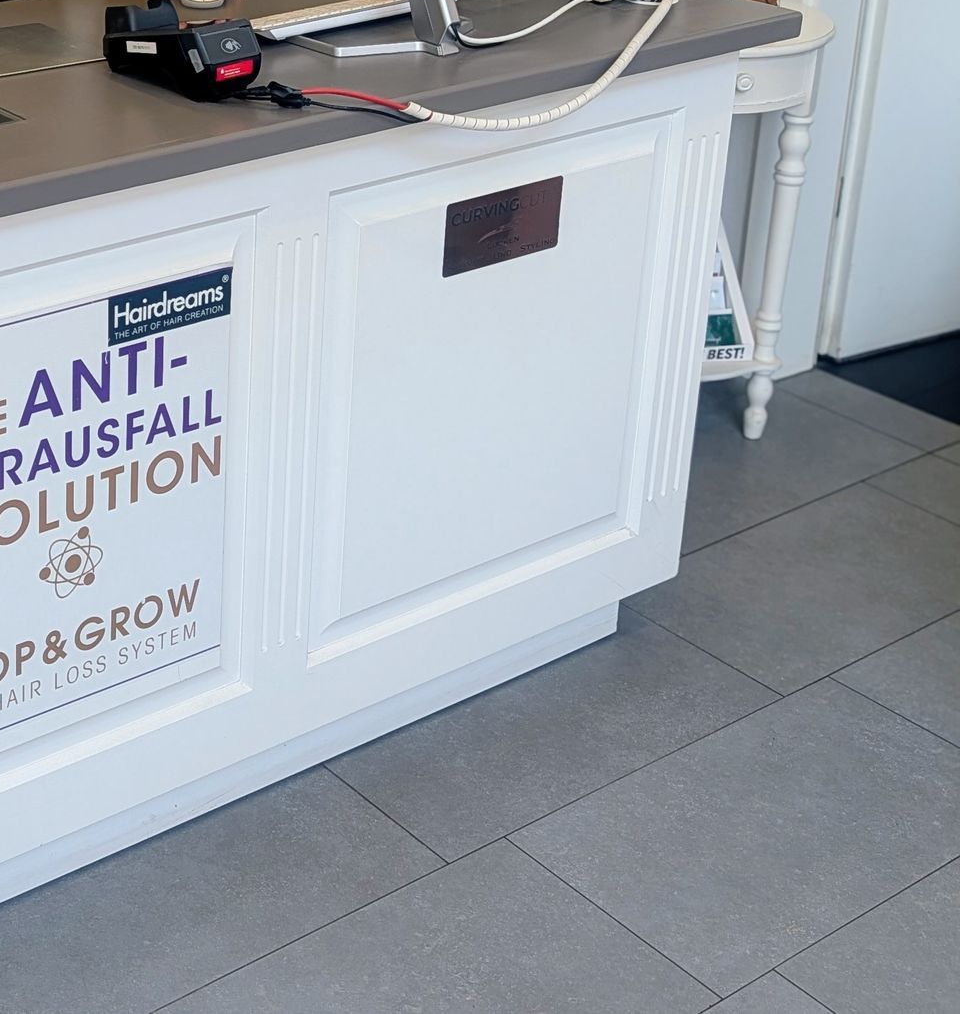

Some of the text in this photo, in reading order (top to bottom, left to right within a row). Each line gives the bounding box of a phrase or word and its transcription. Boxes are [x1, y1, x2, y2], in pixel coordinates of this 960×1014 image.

[114, 304, 224, 340] THE ART OF HAIR CREATION
[707, 347, 745, 360] BEST!
[18, 336, 188, 428] ANTI-
[54, 655, 107, 691] LOSS
[118, 621, 197, 666] SYSTEM
